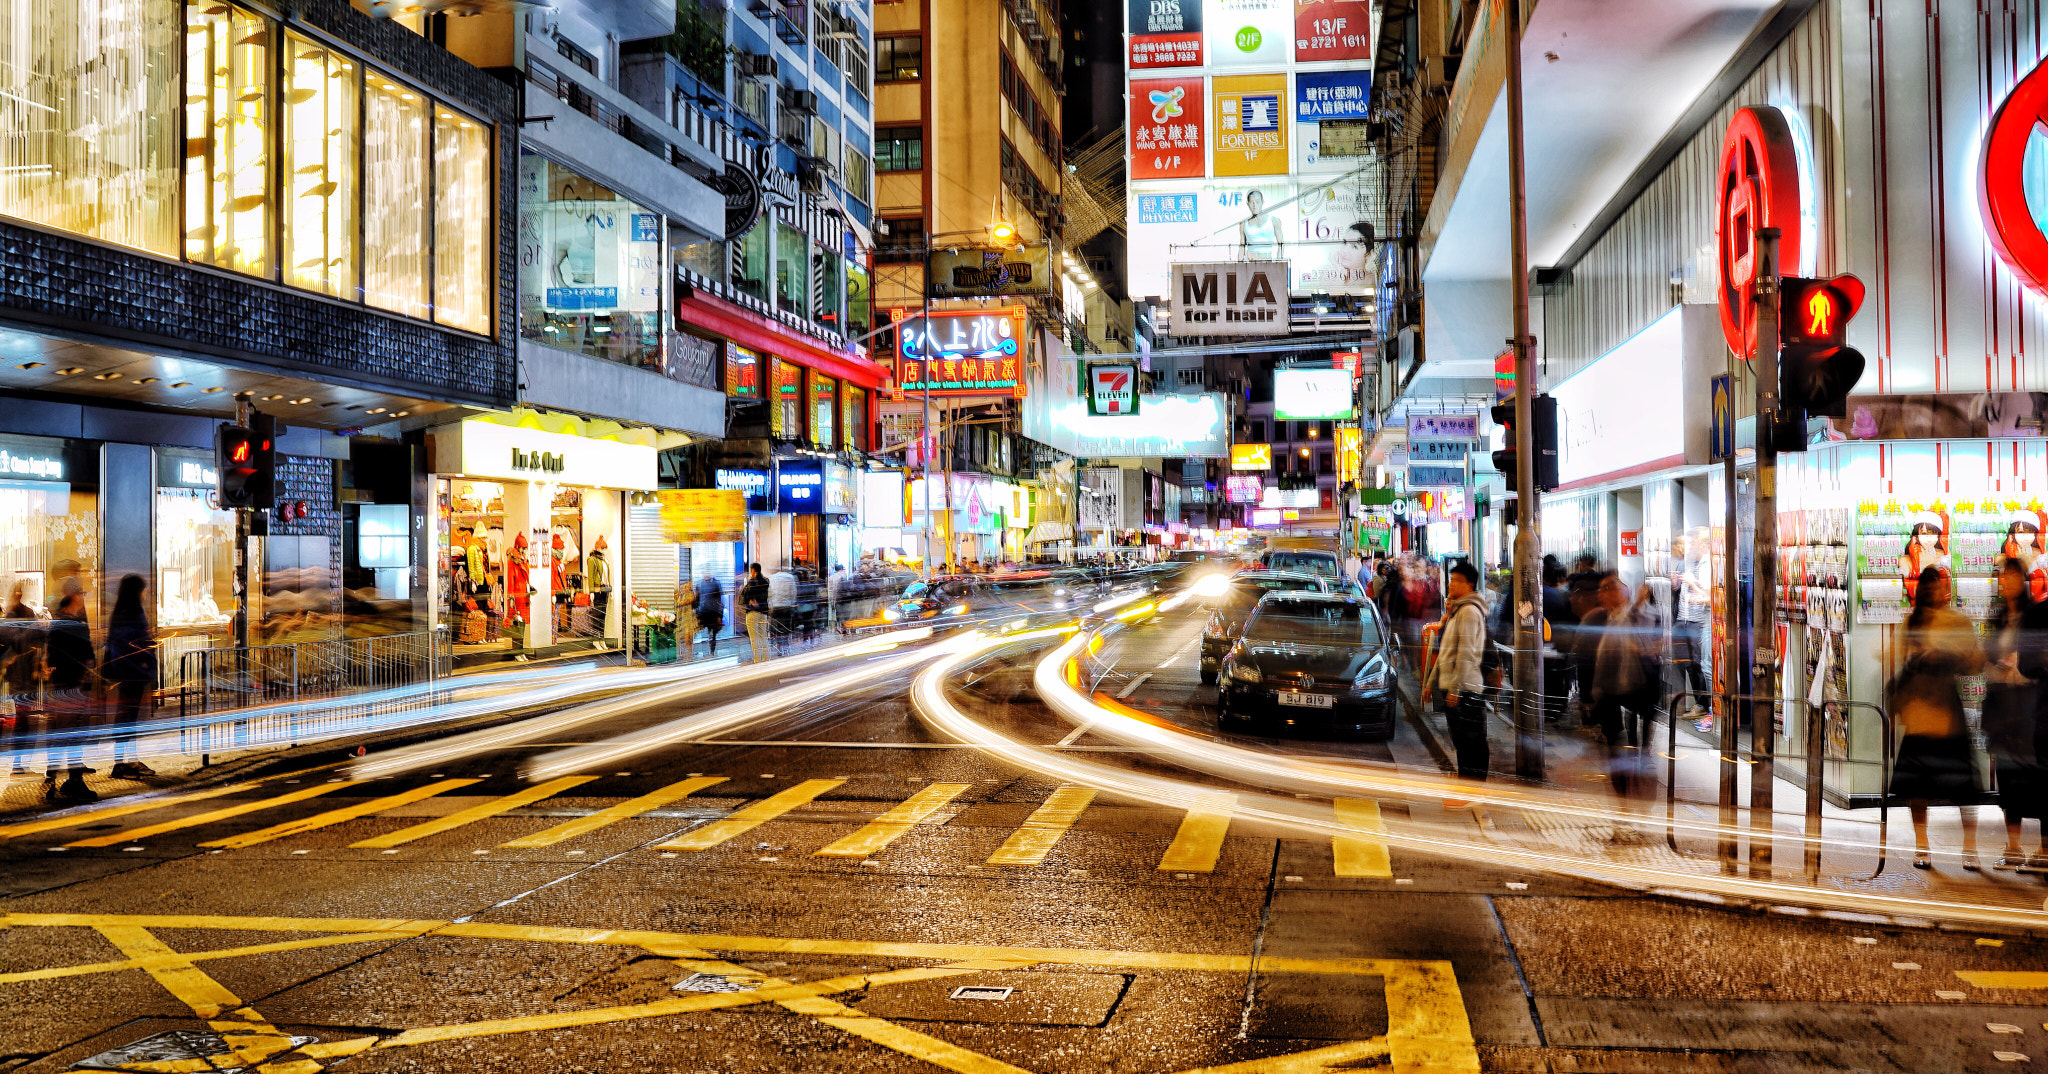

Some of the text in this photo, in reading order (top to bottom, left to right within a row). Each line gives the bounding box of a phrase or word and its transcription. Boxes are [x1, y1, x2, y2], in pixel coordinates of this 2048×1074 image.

[1151, 0, 1180, 15] DBS
[1313, 18, 1347, 35] 13/F
[1238, 32, 1259, 47] 2/F
[1311, 35, 1336, 48] 2721
[1136, 123, 1199, 141] 永安旅遊
[1136, 138, 1199, 150] WING ON TRAVEL
[1221, 133, 1280, 148] FORTRESS
[1142, 196, 1195, 212] 舒適堡
[1218, 192, 1243, 207] 4/F
[1142, 211, 1195, 223] PHYSICAL
[1182, 272, 1277, 305] MIA
[1184, 308, 1277, 323] for hair
[1099, 371, 1128, 390] 7
[530, 451, 541, 469] &
[416, 515, 424, 530] 51
[1286, 693, 1325, 705] SJ 819
